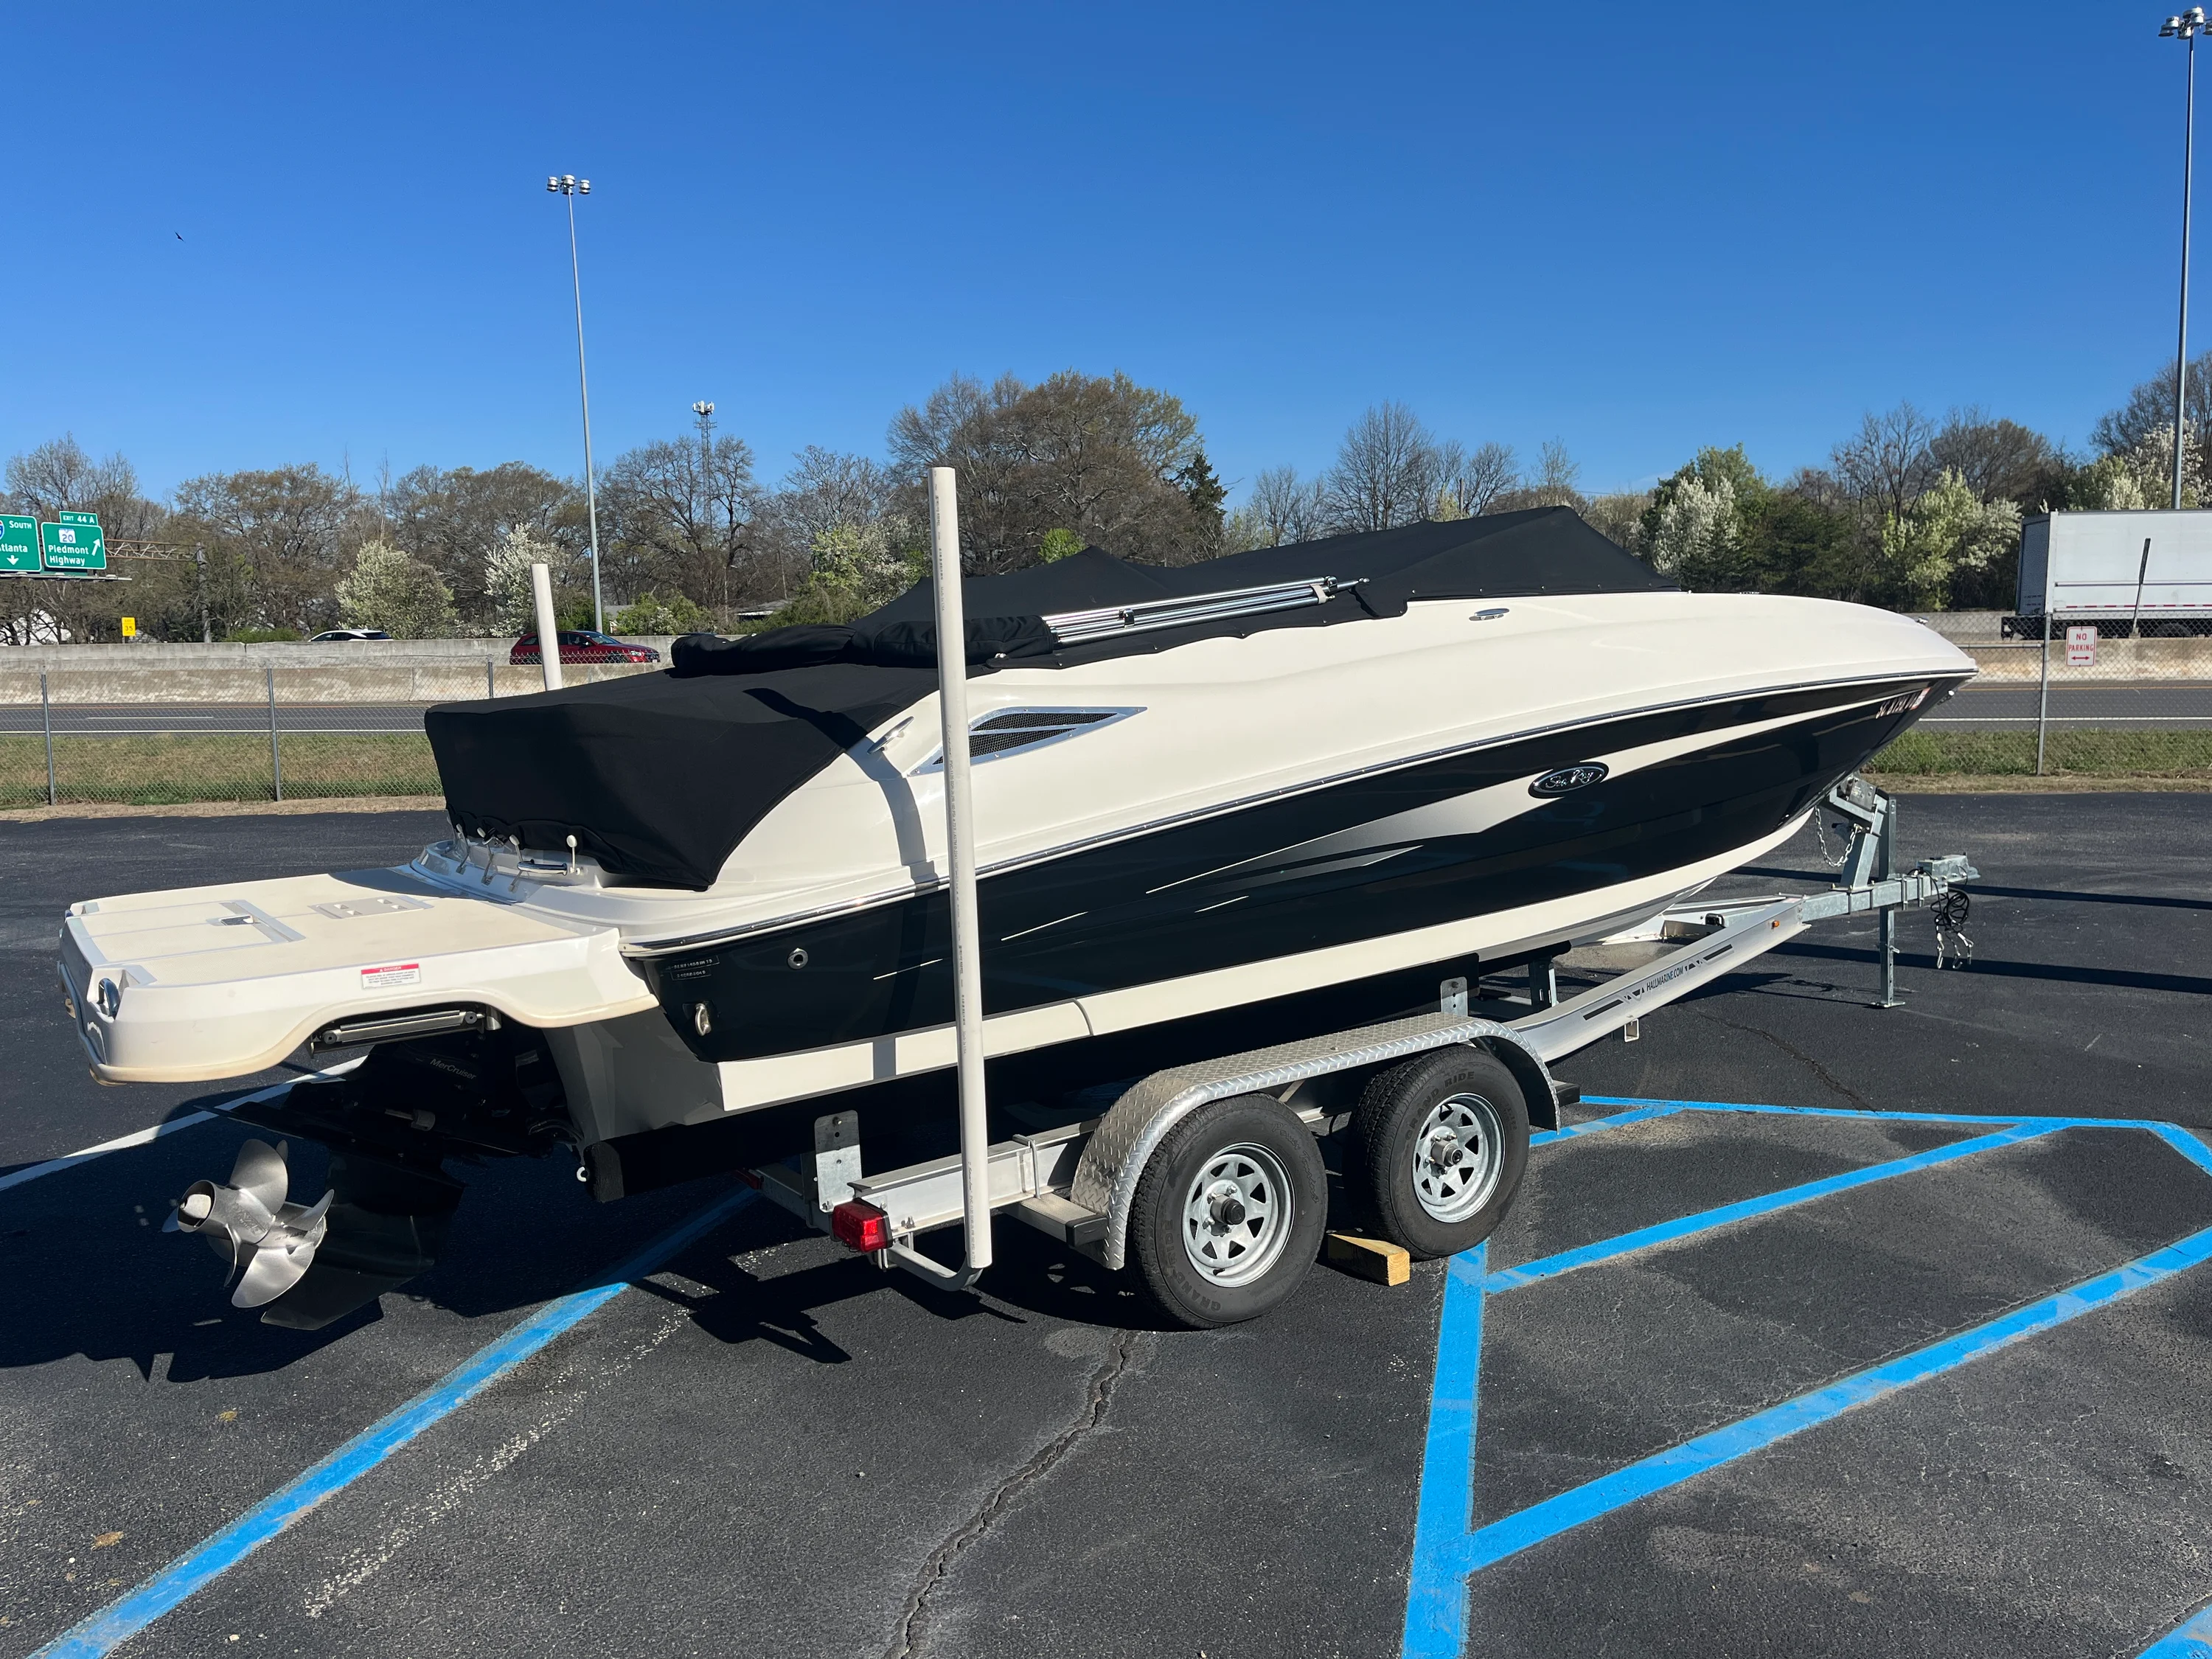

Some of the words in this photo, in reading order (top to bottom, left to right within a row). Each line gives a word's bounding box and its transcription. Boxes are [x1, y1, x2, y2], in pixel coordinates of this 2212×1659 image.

[62, 534, 74, 542] 20
[48, 544, 89, 554] Piedmont
[49, 555, 86, 566] Highway
[2067, 644, 2094, 652] PARKING
[1545, 775, 1568, 788] Sea
[1571, 769, 1594, 784] Ray
[1646, 966, 1683, 991] HALLMARINE.COM
[430, 1058, 477, 1080] MerCruiser
[1405, 1088, 1439, 1141] GRAND
[1444, 1071, 1475, 1088] RIDE
[1165, 1219, 1177, 1266] RIDE
[1176, 1271, 1221, 1311] GRAND
